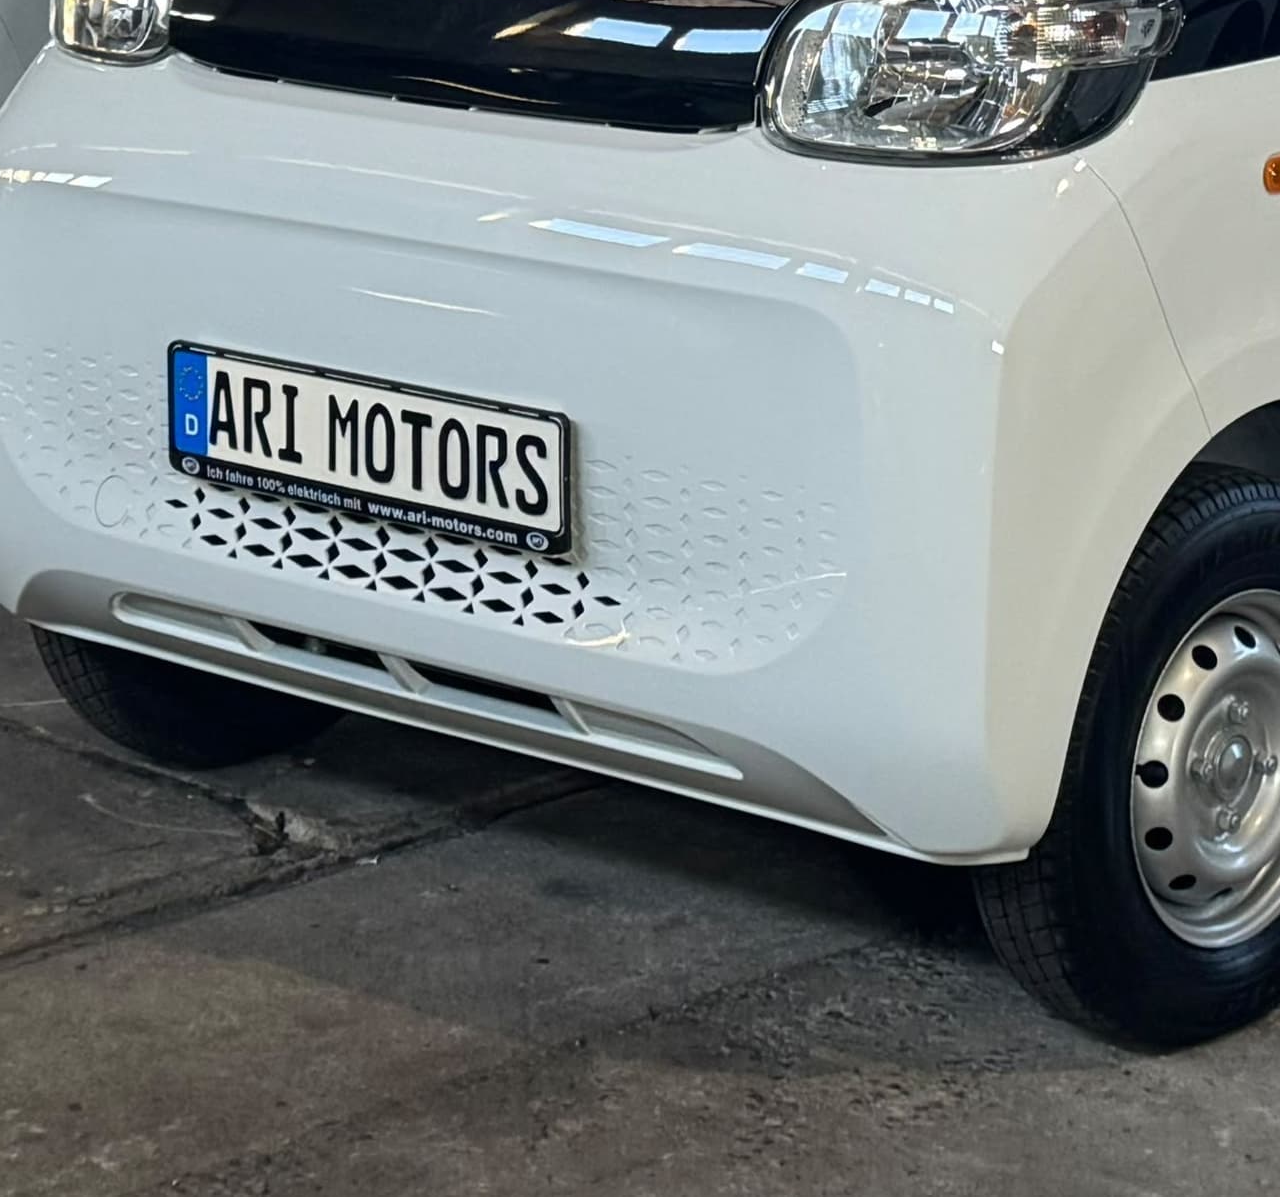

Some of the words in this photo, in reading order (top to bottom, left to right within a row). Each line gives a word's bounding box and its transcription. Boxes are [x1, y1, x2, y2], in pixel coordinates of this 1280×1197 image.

[185, 414, 199, 436] D
[209, 371, 303, 464] ARI
[328, 394, 549, 516] MOTORS
[207, 465, 223, 481] Ich
[226, 469, 254, 487] fahre
[257, 476, 286, 494] 100%
[287, 483, 341, 506] elektrisch
[343, 496, 362, 511] mit
[367, 502, 518, 545] www.ari-motors.com
